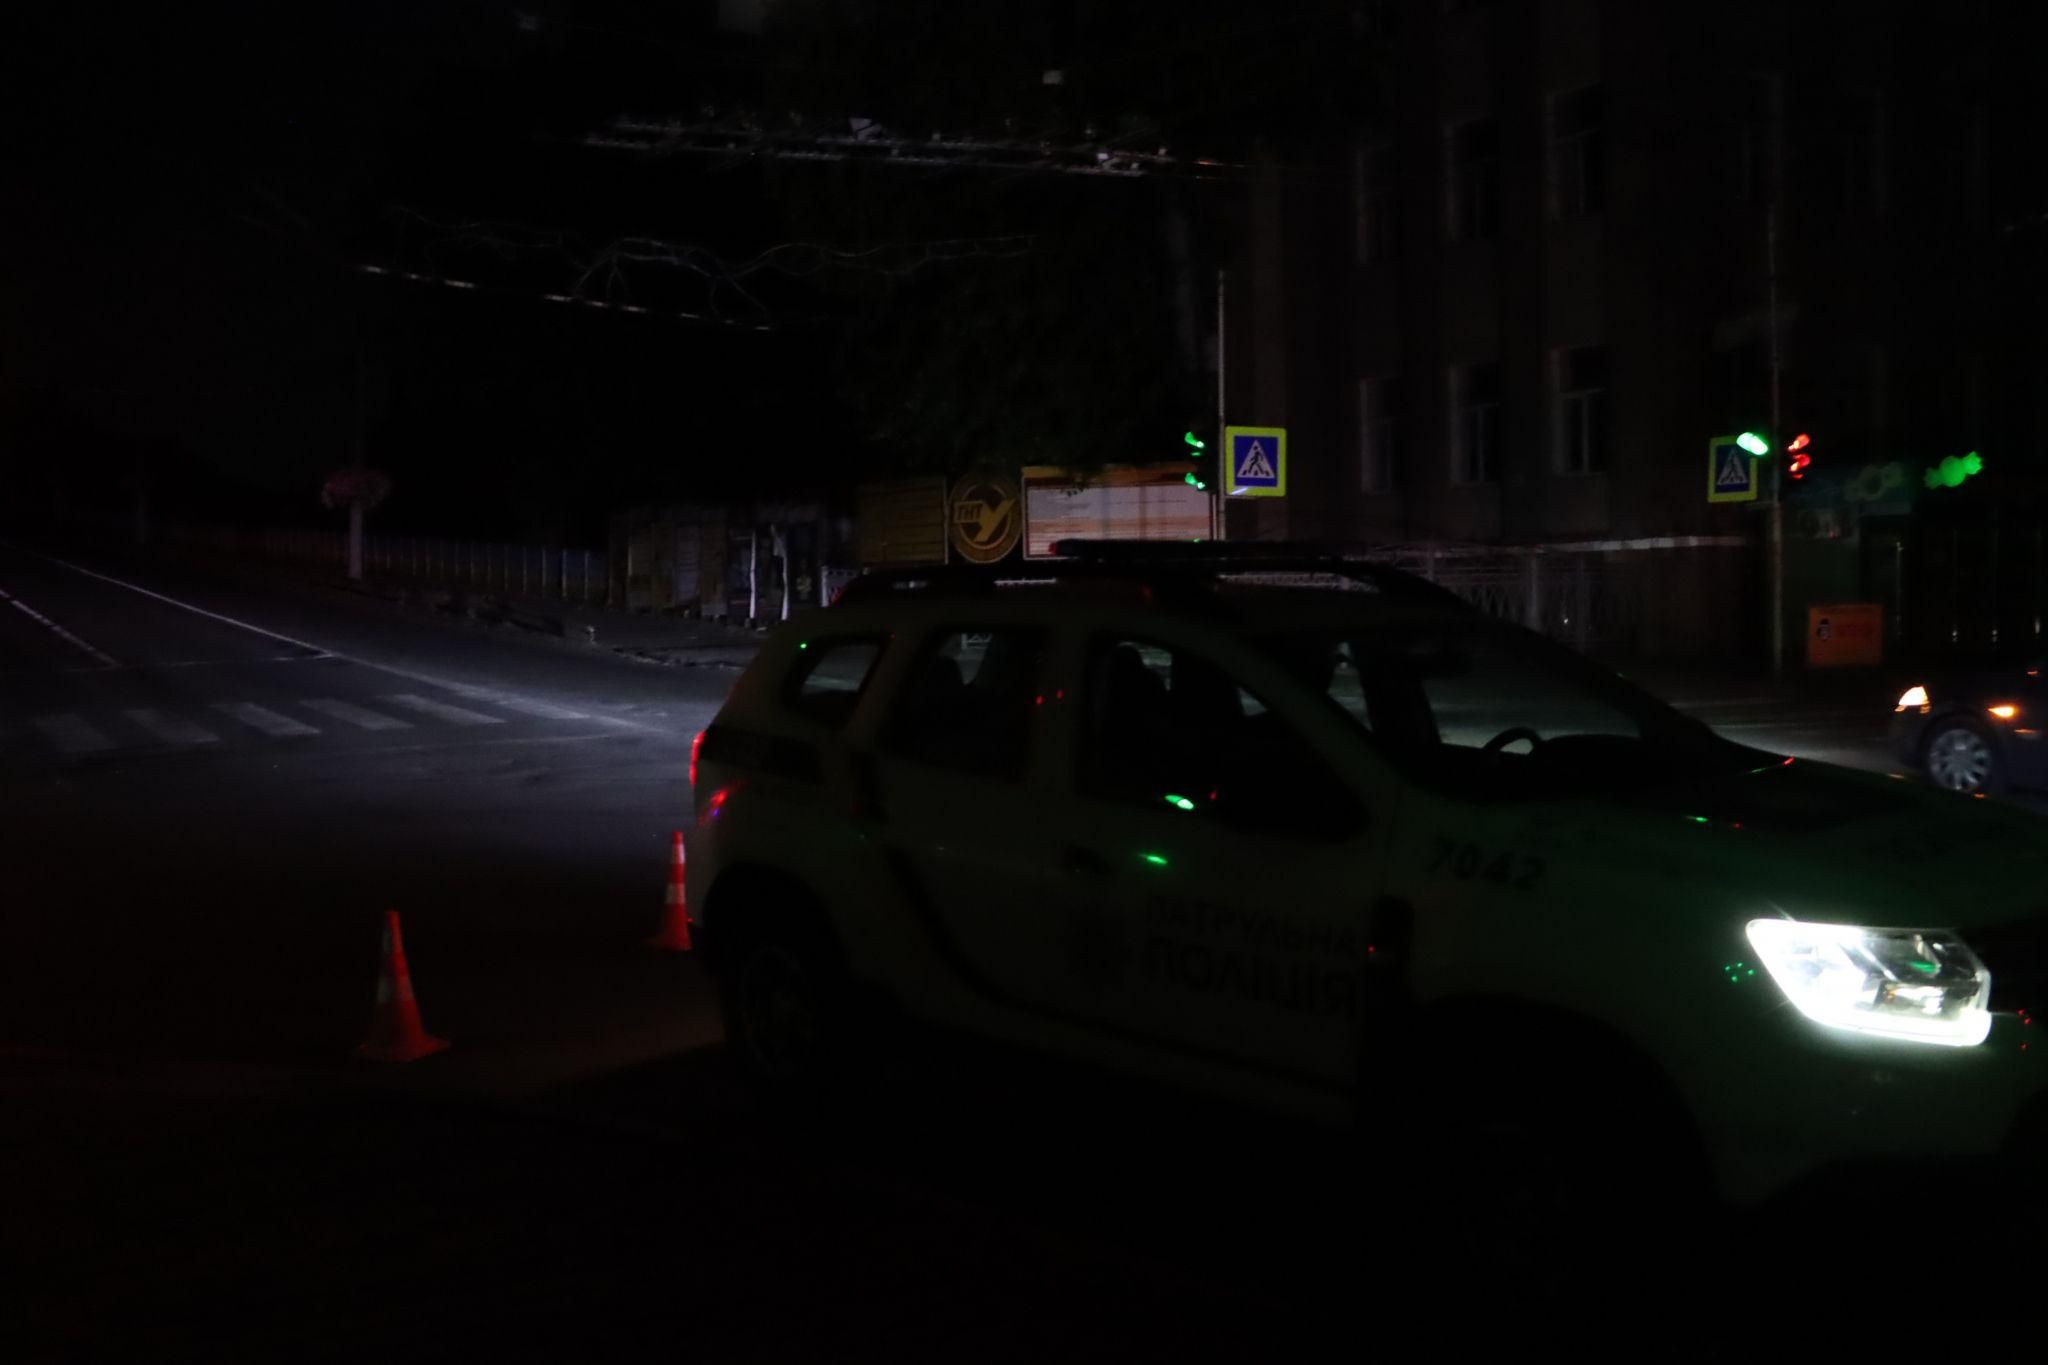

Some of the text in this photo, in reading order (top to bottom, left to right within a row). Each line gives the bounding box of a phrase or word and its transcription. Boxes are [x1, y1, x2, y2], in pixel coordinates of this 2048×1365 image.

[1429, 837, 1545, 890] 7042
[1147, 896, 1359, 957] ПАТРУЛЬНА
[1146, 938, 1358, 1018] ПОЛІЦІЯ
